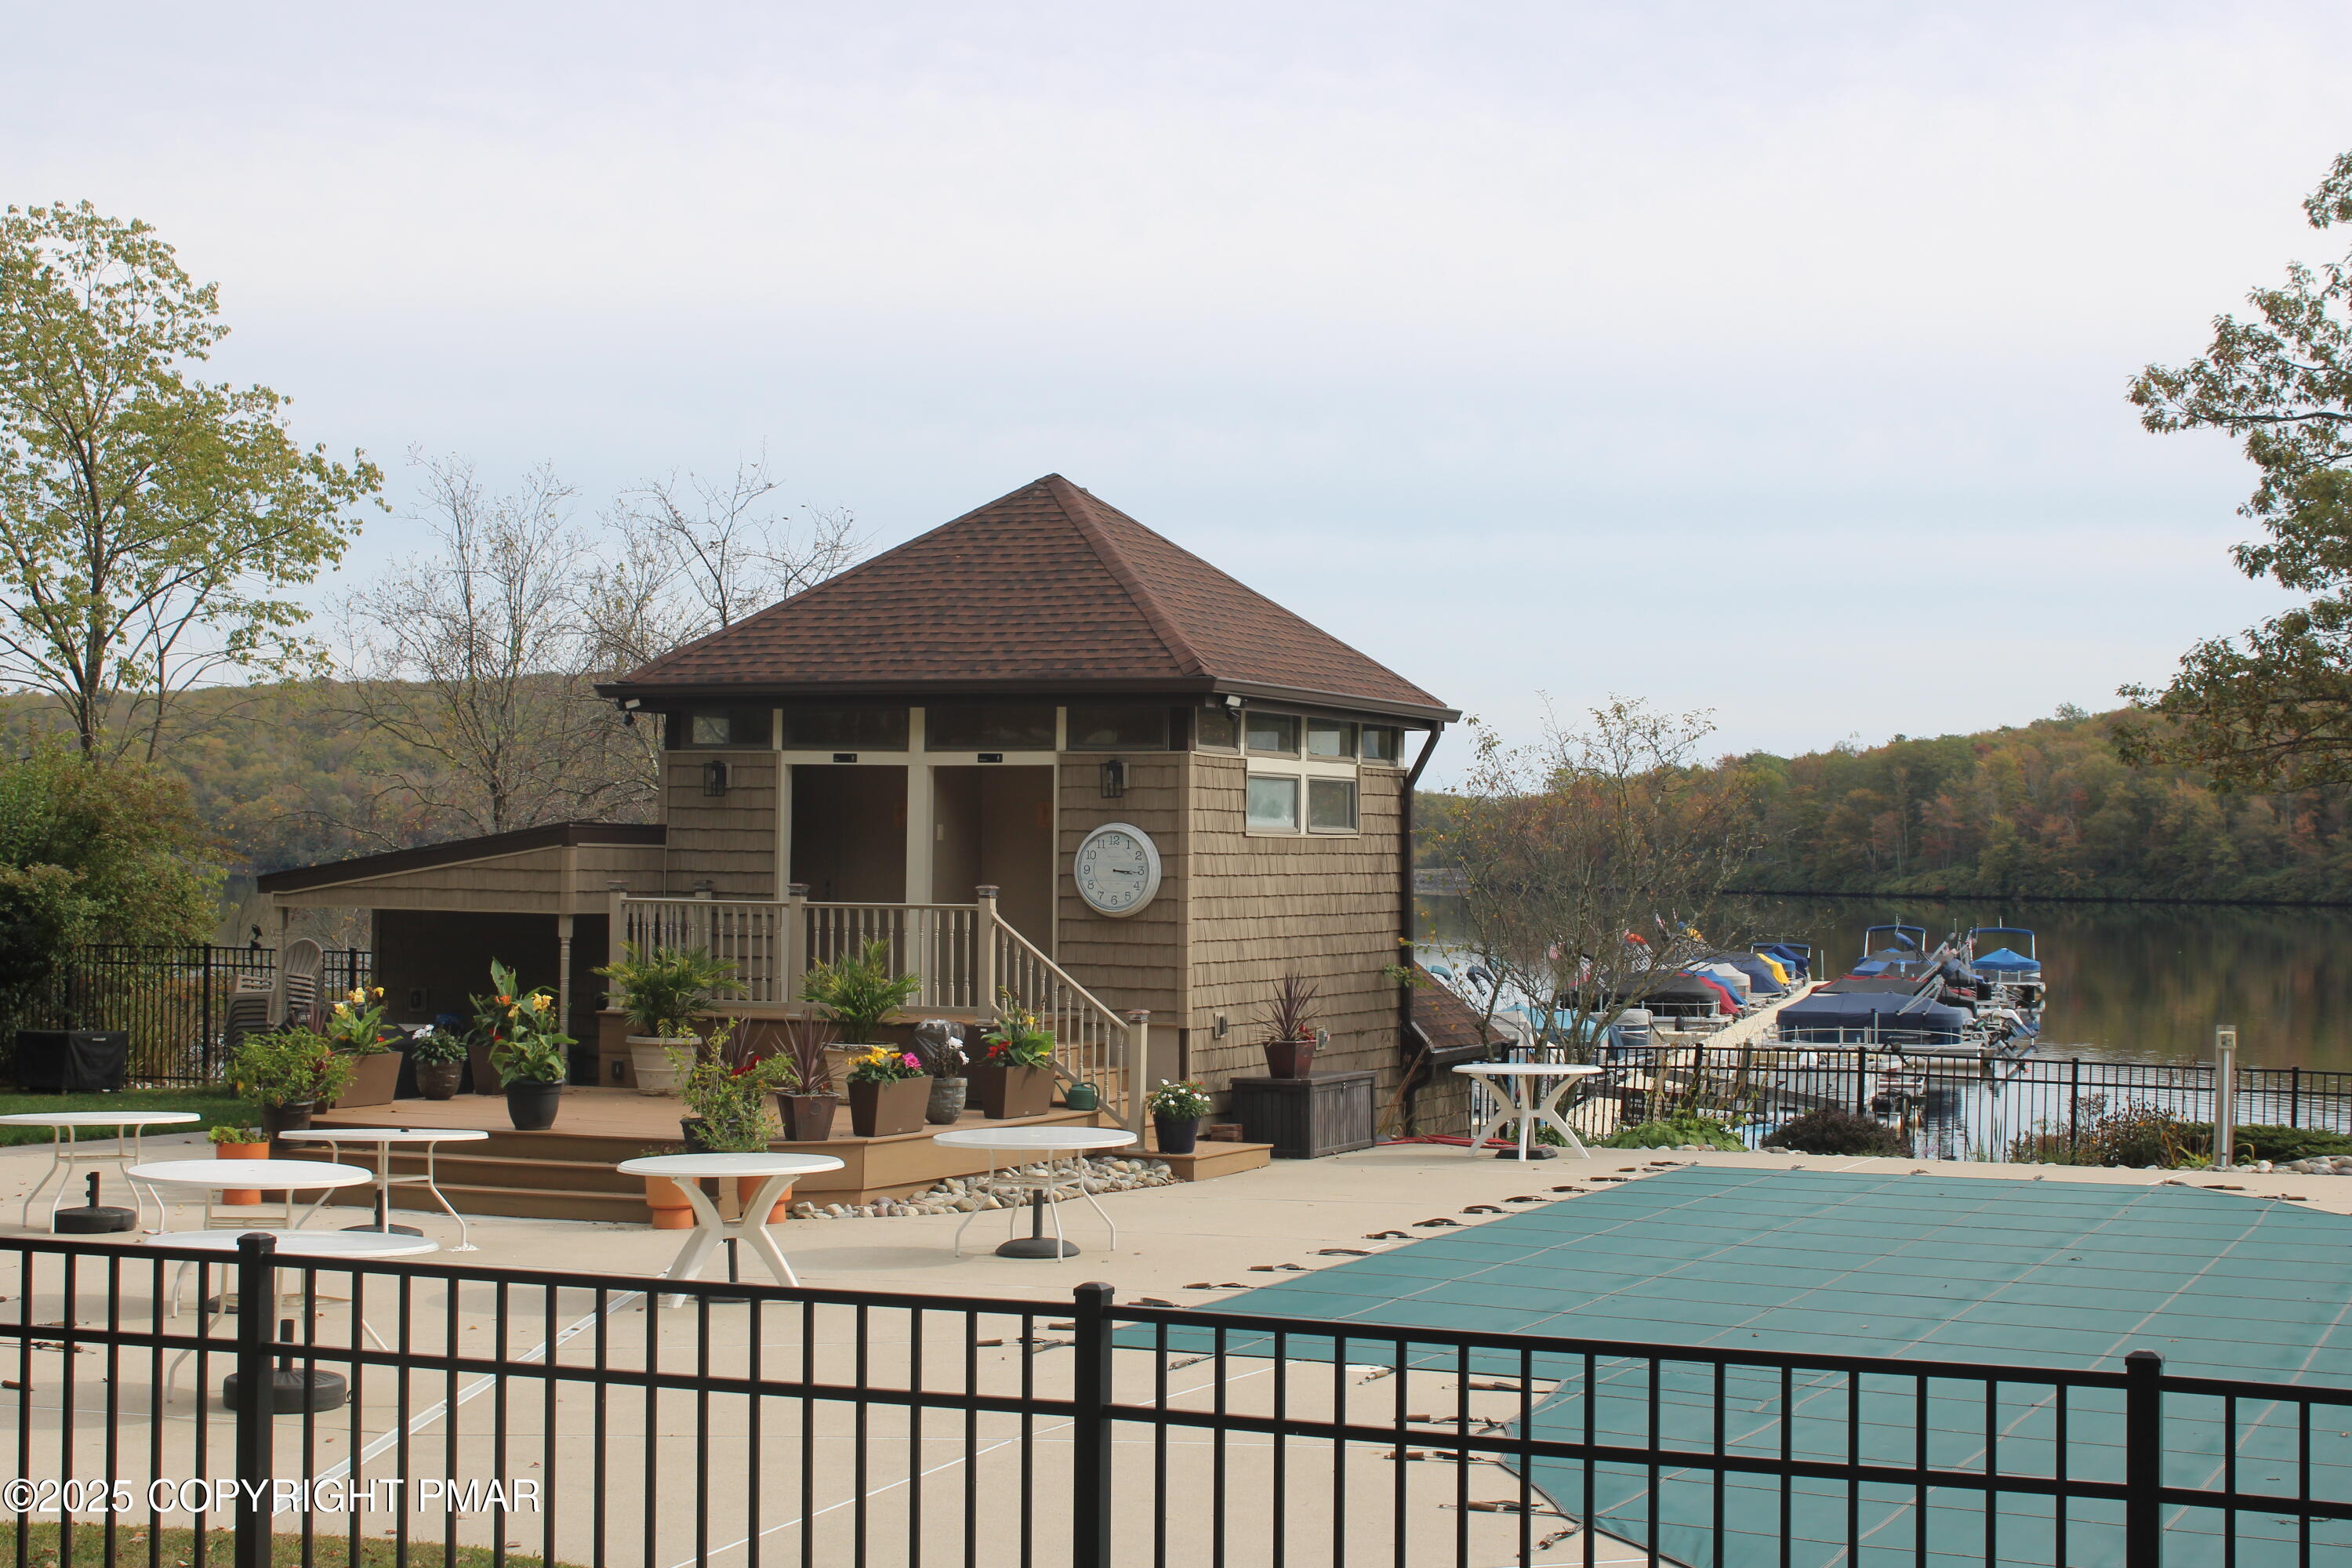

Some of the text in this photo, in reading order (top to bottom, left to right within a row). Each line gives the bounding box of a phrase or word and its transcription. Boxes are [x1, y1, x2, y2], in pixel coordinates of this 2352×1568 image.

[1098, 839, 1105, 848] 11
[1109, 835, 1120, 846] 12
[1126, 840, 1131, 849] 1
[1087, 850, 1096, 860] 10
[1135, 851, 1142, 861] 2
[1083, 865, 1091, 874] 9
[1138, 866, 1145, 876] 3
[1087, 880, 1094, 890] 8
[1134, 881, 1141, 891] 4
[1098, 891, 1105, 900] 7
[1111, 895, 1118, 905] 6
[1124, 891, 1131, 901] 5
